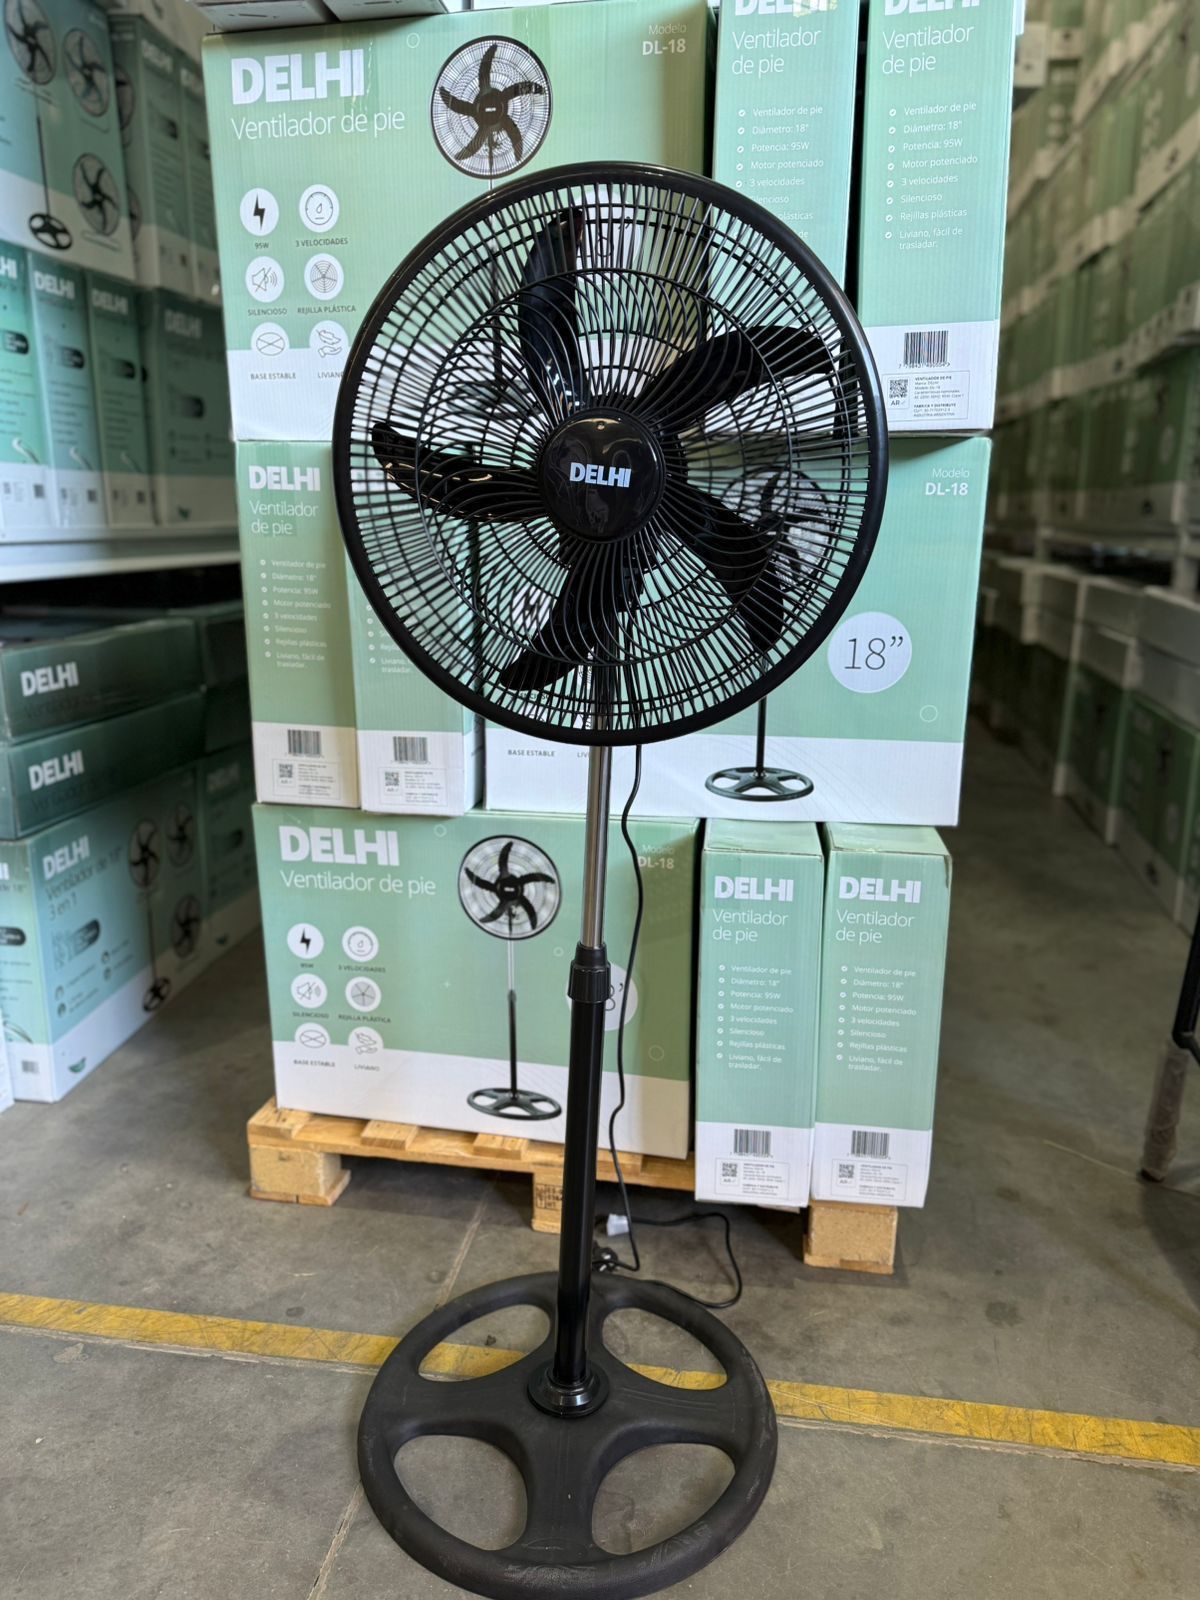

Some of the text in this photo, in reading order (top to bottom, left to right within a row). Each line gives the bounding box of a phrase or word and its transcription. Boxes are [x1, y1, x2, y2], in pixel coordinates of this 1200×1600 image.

[648, 24, 686, 35] Modelo
[732, 26, 821, 50] Ventilador
[882, 24, 974, 49] Ventilador
[642, 38, 686, 55] DL-18
[731, 54, 784, 78] de pie
[882, 53, 936, 77] de pie
[231, 49, 364, 105] DELHI
[752, 105, 823, 117] Ventilador de pie
[904, 101, 977, 116] Ventilador de pie
[230, 106, 405, 140] Ventilador de pie
[751, 141, 810, 152] Potencia: 95W
[903, 138, 963, 151] Potencia: 95W
[750, 159, 824, 171] Motor potenciado
[902, 154, 978, 169] Motor potenciado
[750, 177, 805, 187] 3 velocidades
[901, 174, 958, 186] 3 velocidades
[900, 193, 942, 204] Silencioso
[900, 210, 929, 221] Rejillas
[952, 226, 963, 236] de
[254, 242, 269, 250] 95W
[295, 237, 349, 248] 3 VELOCIDADES
[33, 270, 75, 300] DELHI
[92, 288, 128, 316] DELHI
[297, 305, 356, 315] REJILLA PLÁSTICA
[247, 308, 288, 316] SILENCIOSO
[269, 372, 296, 380] ESTABLE
[248, 465, 321, 491] DELHI
[569, 462, 631, 488] DELHI
[932, 467, 970, 479] Modelo
[925, 482, 969, 496] DL-18
[249, 500, 319, 517] Ventilador
[251, 519, 293, 537] de pie
[20, 661, 79, 697] DELHI
[508, 749, 555, 758] BASE ESTABLE
[28, 750, 84, 791] DELHI
[278, 825, 400, 866] DELHI
[42, 835, 90, 880] DELHI
[638, 855, 674, 870] DL-18
[280, 870, 436, 899] Ventilador de pie
[714, 875, 795, 902] DELHI
[838, 876, 922, 903] DELHI
[712, 908, 788, 926] Ventilador
[836, 908, 915, 927] Ventilador
[712, 926, 758, 944] de pie
[835, 926, 882, 945] de pie
